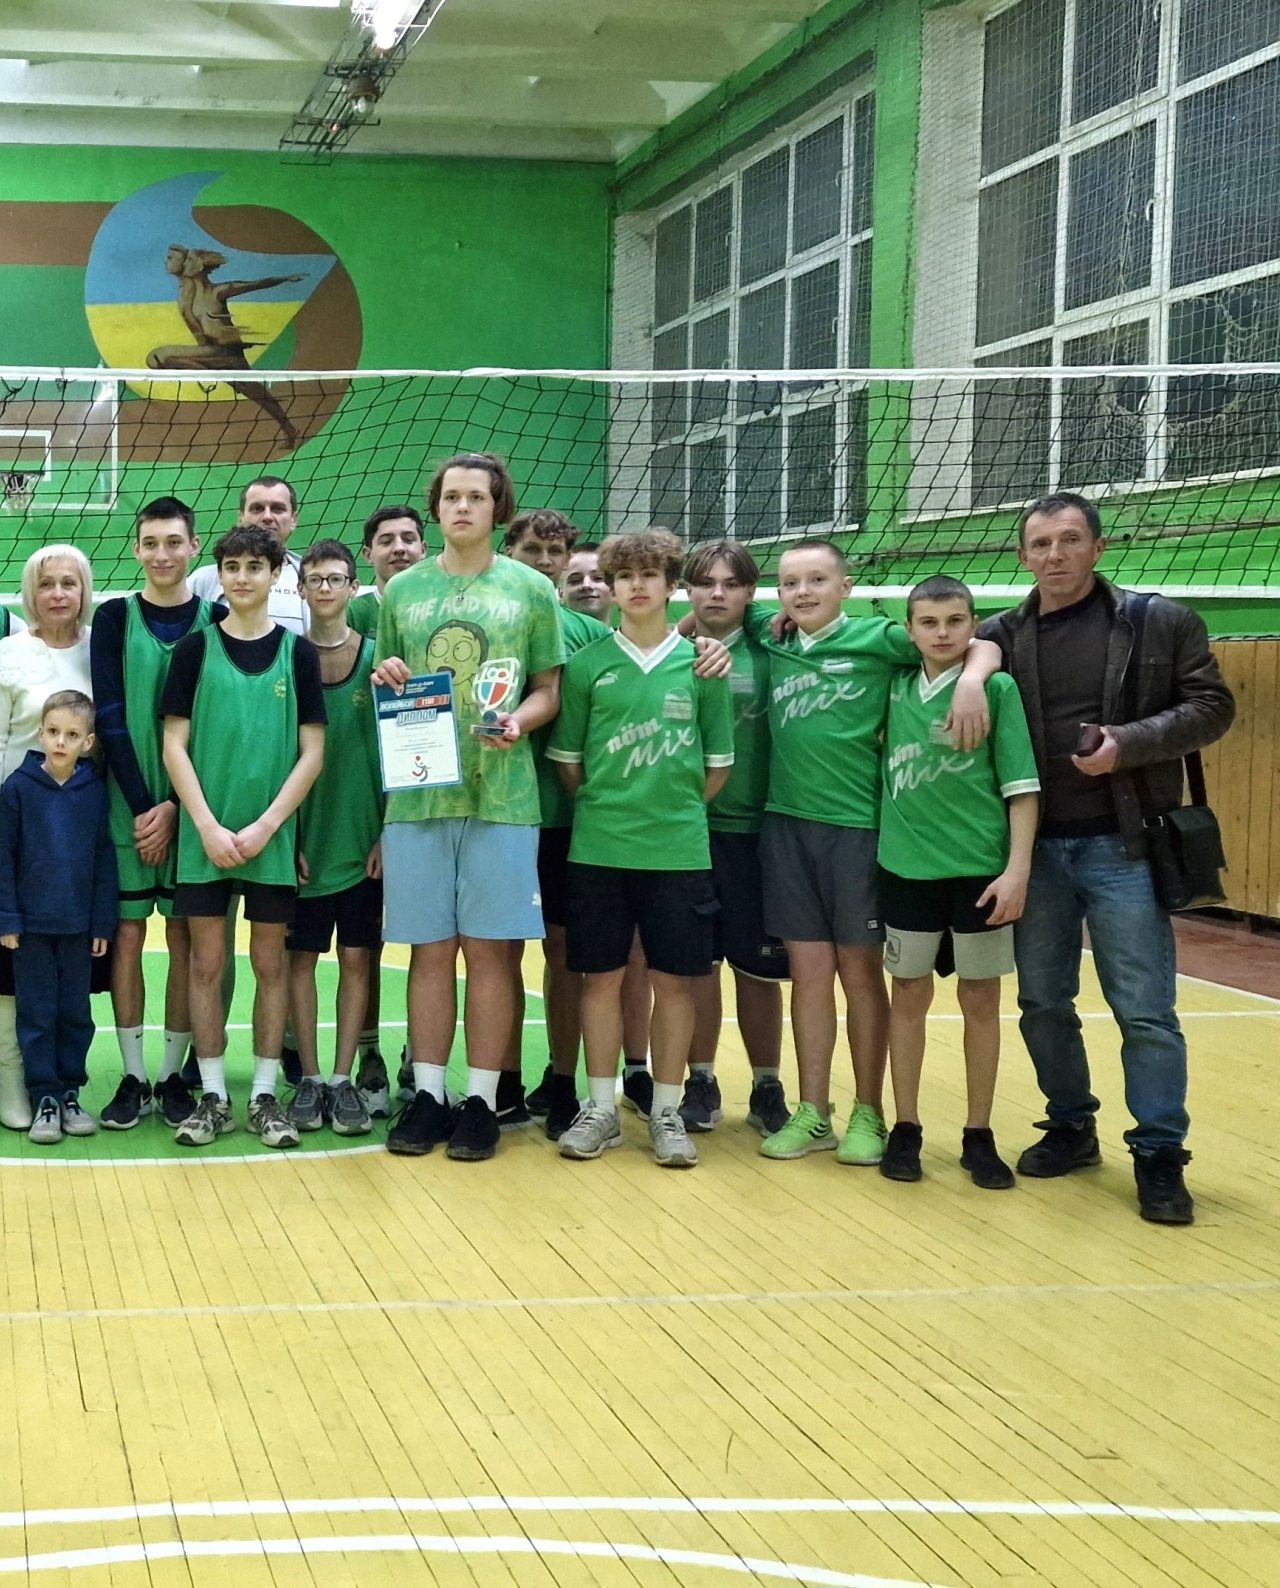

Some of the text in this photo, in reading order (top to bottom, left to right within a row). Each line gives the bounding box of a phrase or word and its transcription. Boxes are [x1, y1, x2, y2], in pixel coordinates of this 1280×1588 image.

[406, 597, 437, 624] THE
[781, 681, 867, 729] Mix
[607, 718, 662, 753] nöm
[622, 726, 696, 778] Mix
[892, 754, 974, 800] Mix
